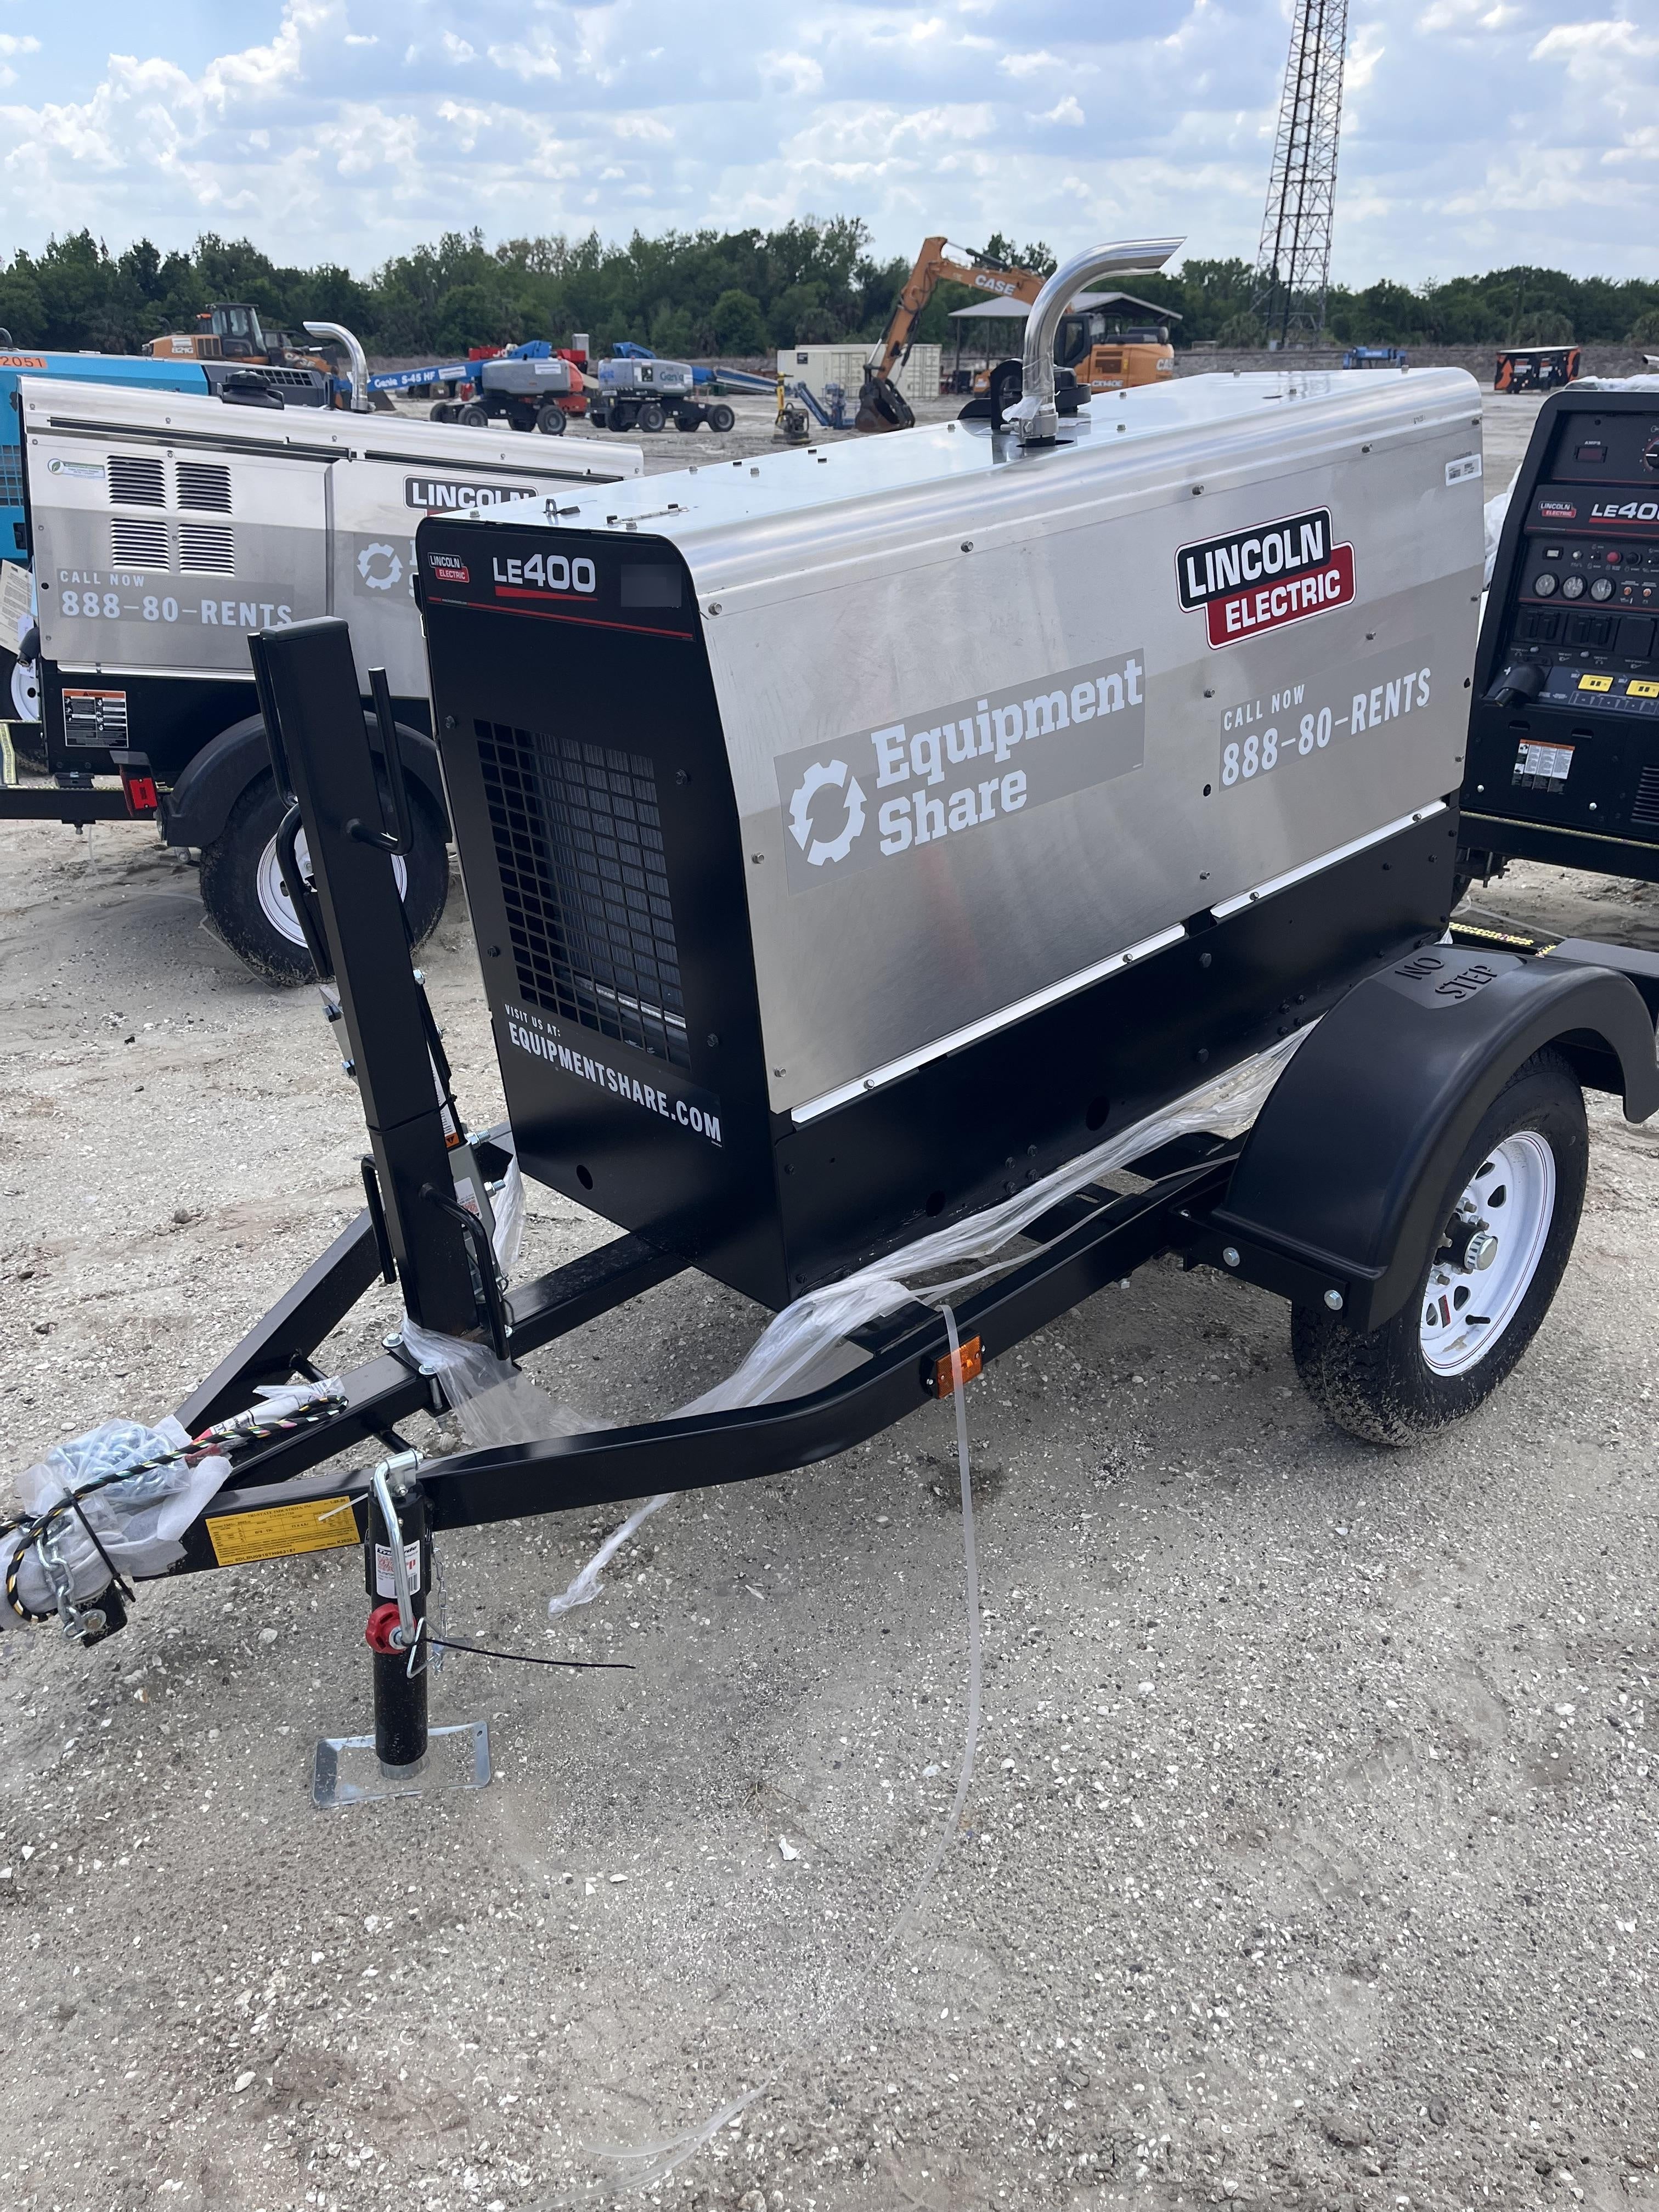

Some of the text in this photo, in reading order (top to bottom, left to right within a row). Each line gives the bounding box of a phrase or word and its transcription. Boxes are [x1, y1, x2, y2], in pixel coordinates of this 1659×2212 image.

[975, 274, 1015, 296] CASE
[0, 356, 42, 368] 2051
[374, 377, 398, 388] Genie
[401, 373, 421, 385] S-45
[424, 371, 436, 381] HF
[1591, 502, 1659, 521] LE40
[430, 555, 460, 568] LINCOLN
[439, 569, 466, 579] ELECTRIC
[493, 554, 596, 593] LE400
[1186, 520, 1324, 599] LINCOLN
[60, 571, 145, 587] CALL NOW
[61, 590, 292, 628] 888-80-RENTS
[1226, 569, 1341, 633] ELECTRIC
[870, 658, 1143, 789] Equipment
[1223, 684, 1305, 731] CALL NOW
[1222, 667, 1431, 786] 888-80-RENTS
[877, 769, 1027, 856] Share
[1394, 957, 1445, 980] NO
[1435, 964, 1498, 999] STEP
[504, 1003, 561, 1038] VISIT US AT:
[507, 1021, 722, 1142] EQUIPMENTSHARE.COM
